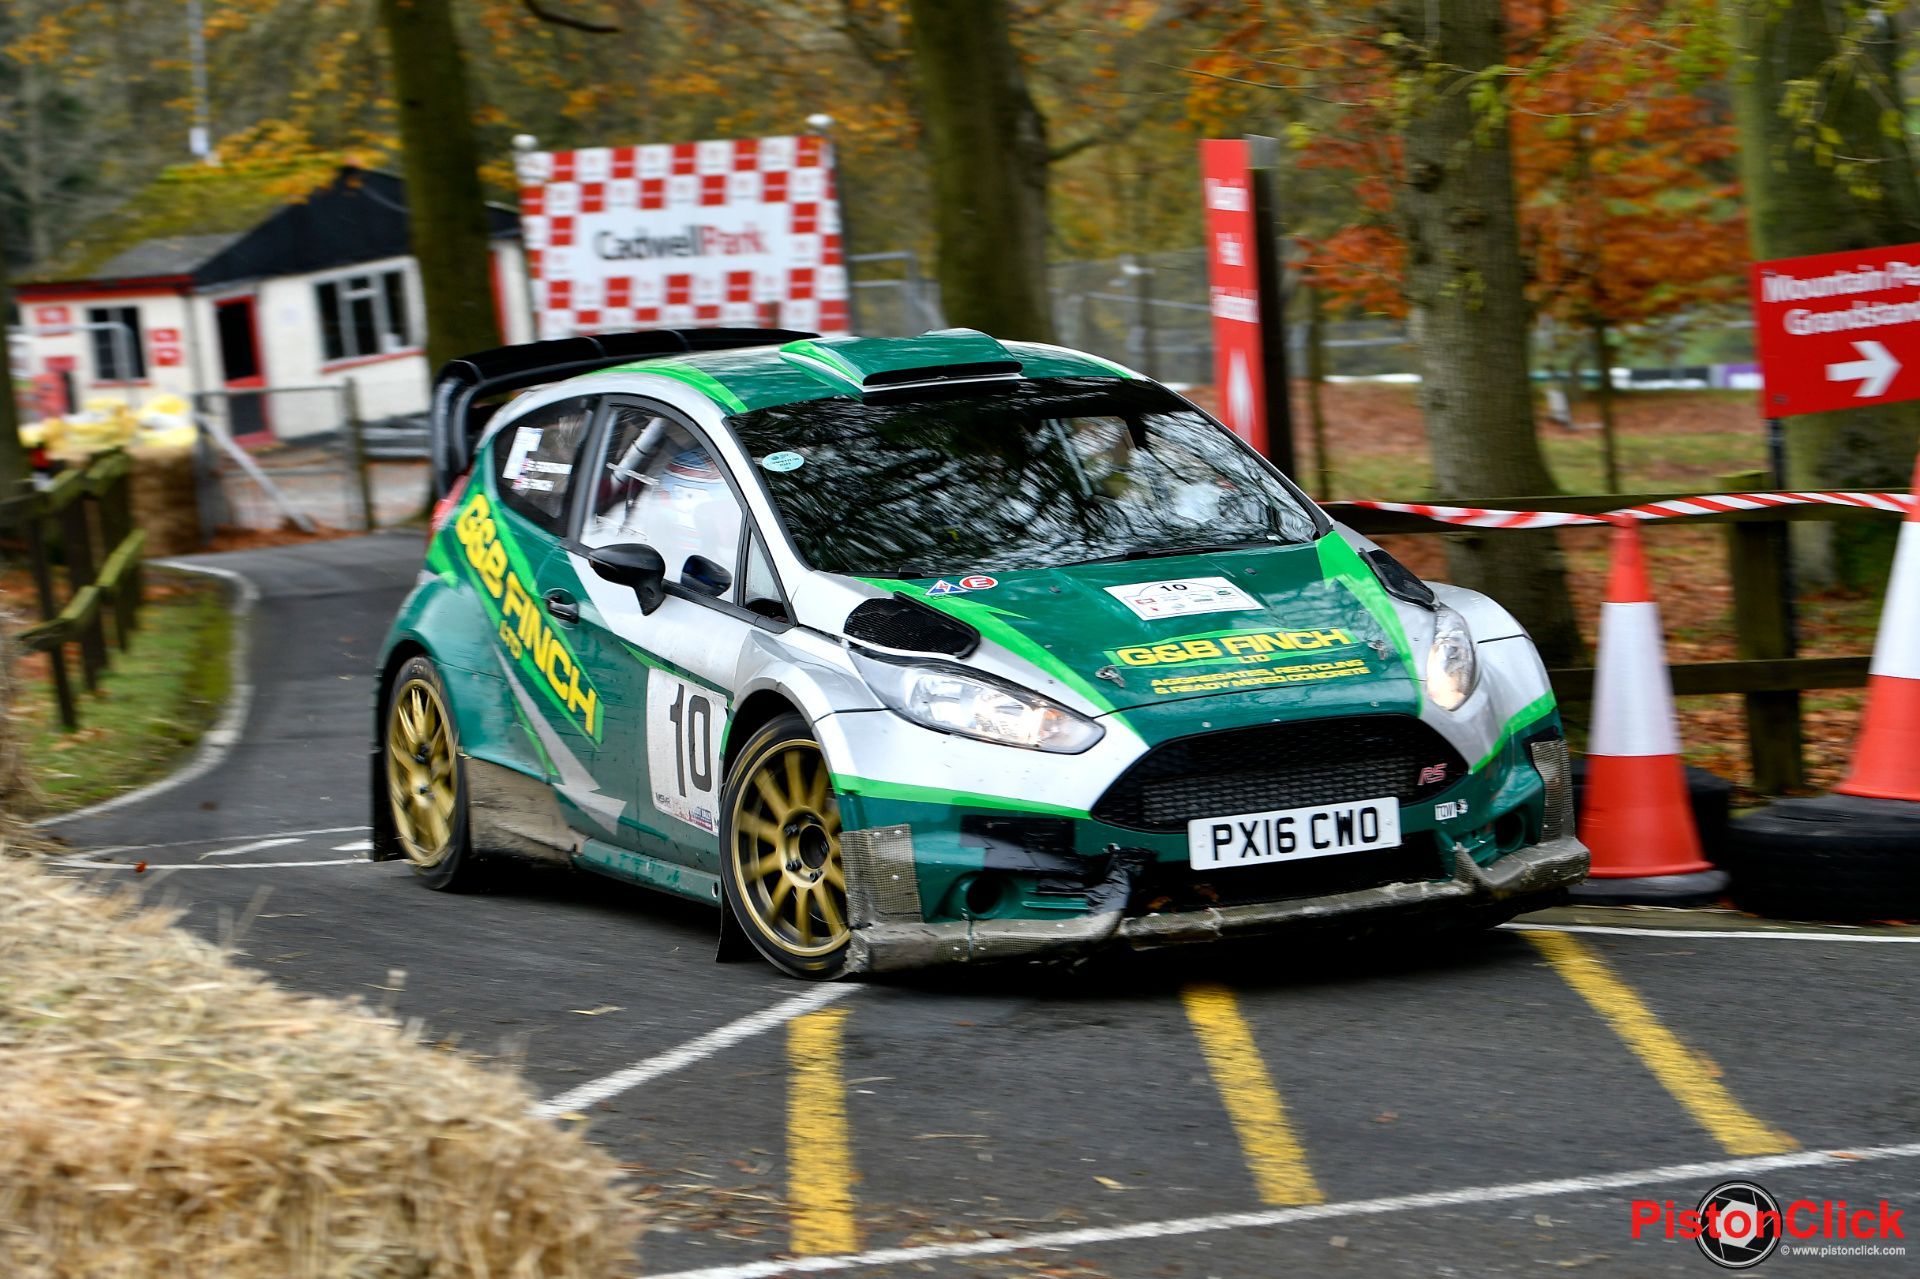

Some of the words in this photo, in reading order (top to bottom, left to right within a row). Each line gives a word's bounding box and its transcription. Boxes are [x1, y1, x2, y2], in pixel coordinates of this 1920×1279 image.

[593, 225, 768, 260] CadwellPark
[1761, 266, 1886, 303] Mountain
[1160, 584, 1188, 592] 10
[455, 494, 508, 598] G&B
[502, 571, 597, 735] FINCH
[1116, 639, 1223, 666] G&B
[1218, 628, 1352, 655] FINCH
[1238, 654, 1271, 664] LTD
[1170, 680, 1232, 693] READY
[1231, 675, 1288, 688] MIXED
[1287, 667, 1371, 682] CONCRETE
[1273, 659, 1365, 674] RECYCLING
[670, 683, 712, 798] 10
[1417, 763, 1448, 785] RS
[1211, 816, 1297, 861] PX16
[1310, 806, 1379, 850] CWO
